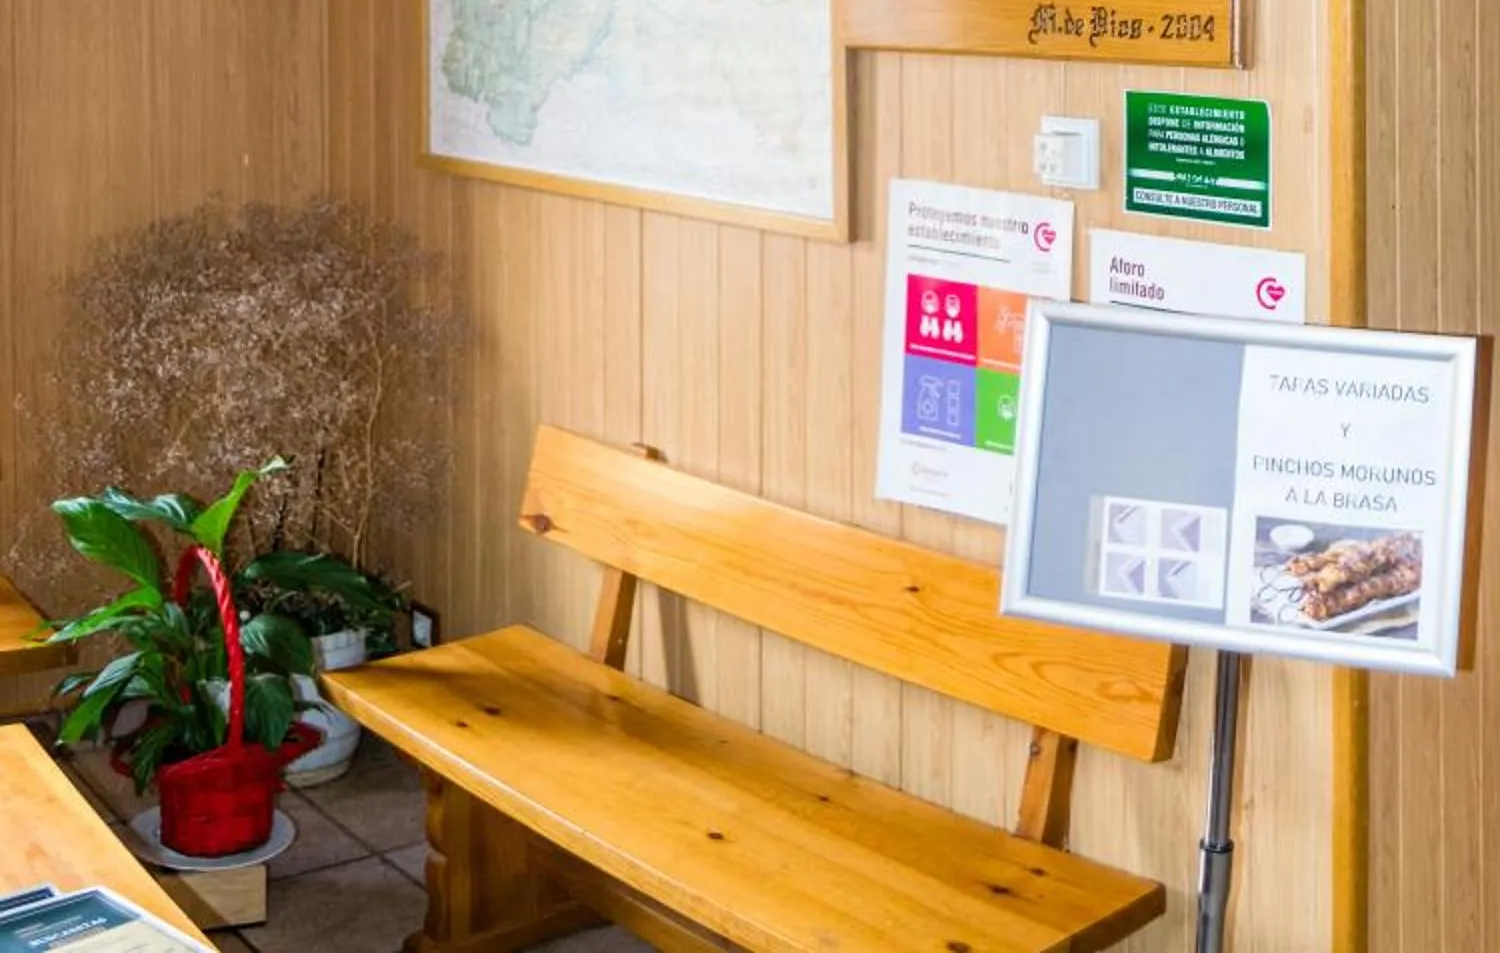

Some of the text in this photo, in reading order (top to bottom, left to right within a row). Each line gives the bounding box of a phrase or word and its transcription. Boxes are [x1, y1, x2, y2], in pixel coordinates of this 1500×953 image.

[1109, 256, 1145, 277] Aforo
[1109, 277, 1165, 301] limitado
[1269, 374, 1430, 404] TAPAS VARIADAS
[1340, 423, 1351, 438] Y
[1252, 454, 1437, 487] PINCHOS MORUNOS
[1284, 488, 1398, 513] A LA BRASA
